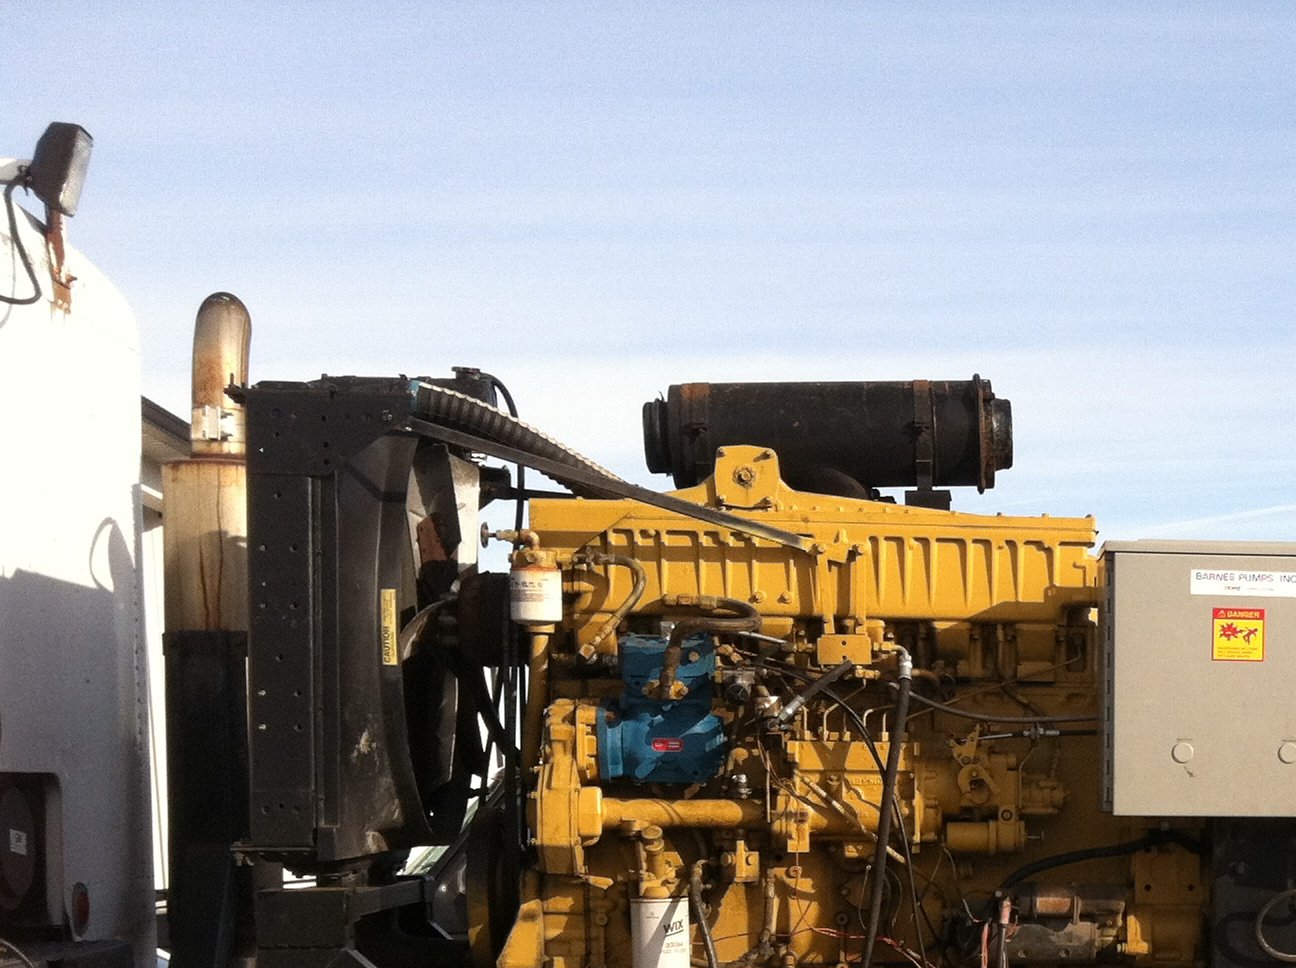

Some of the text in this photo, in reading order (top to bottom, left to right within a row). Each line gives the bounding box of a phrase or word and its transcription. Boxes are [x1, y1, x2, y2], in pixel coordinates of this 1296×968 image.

[1195, 571, 1296, 584] BARNES PUMPS INC
[1227, 610, 1260, 619] DANGER
[383, 625, 392, 663] CAUTION
[663, 918, 684, 934] WIX
